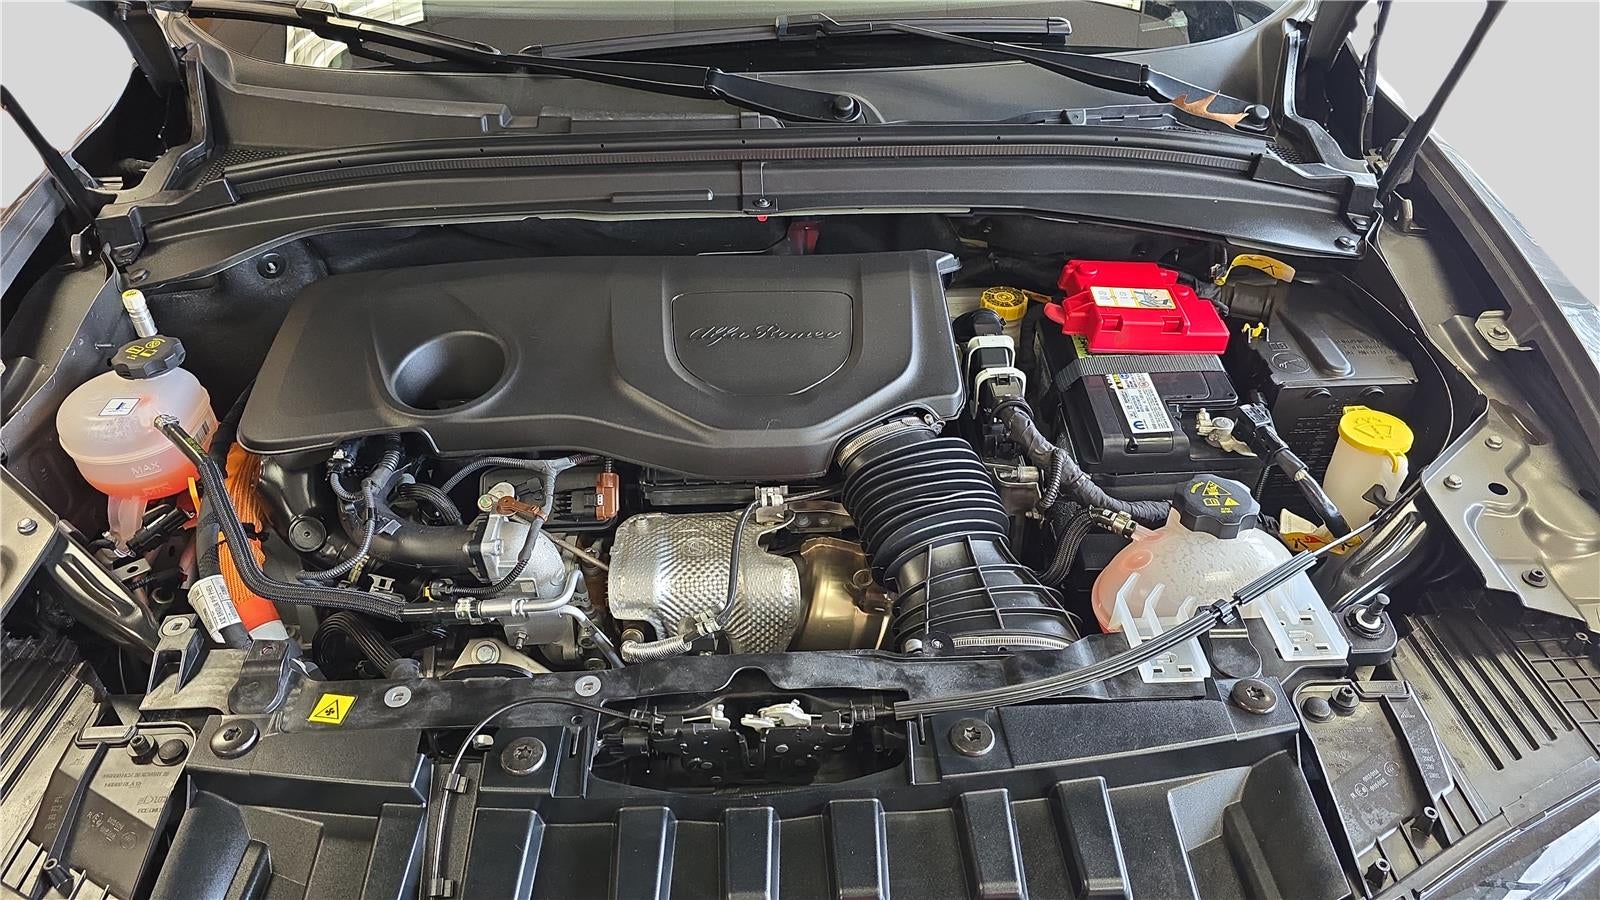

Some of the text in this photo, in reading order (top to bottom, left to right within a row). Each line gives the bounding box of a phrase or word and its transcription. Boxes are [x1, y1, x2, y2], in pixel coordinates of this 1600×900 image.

[688, 323, 842, 347] Alfa Romeo
[130, 461, 160, 475] MAX
